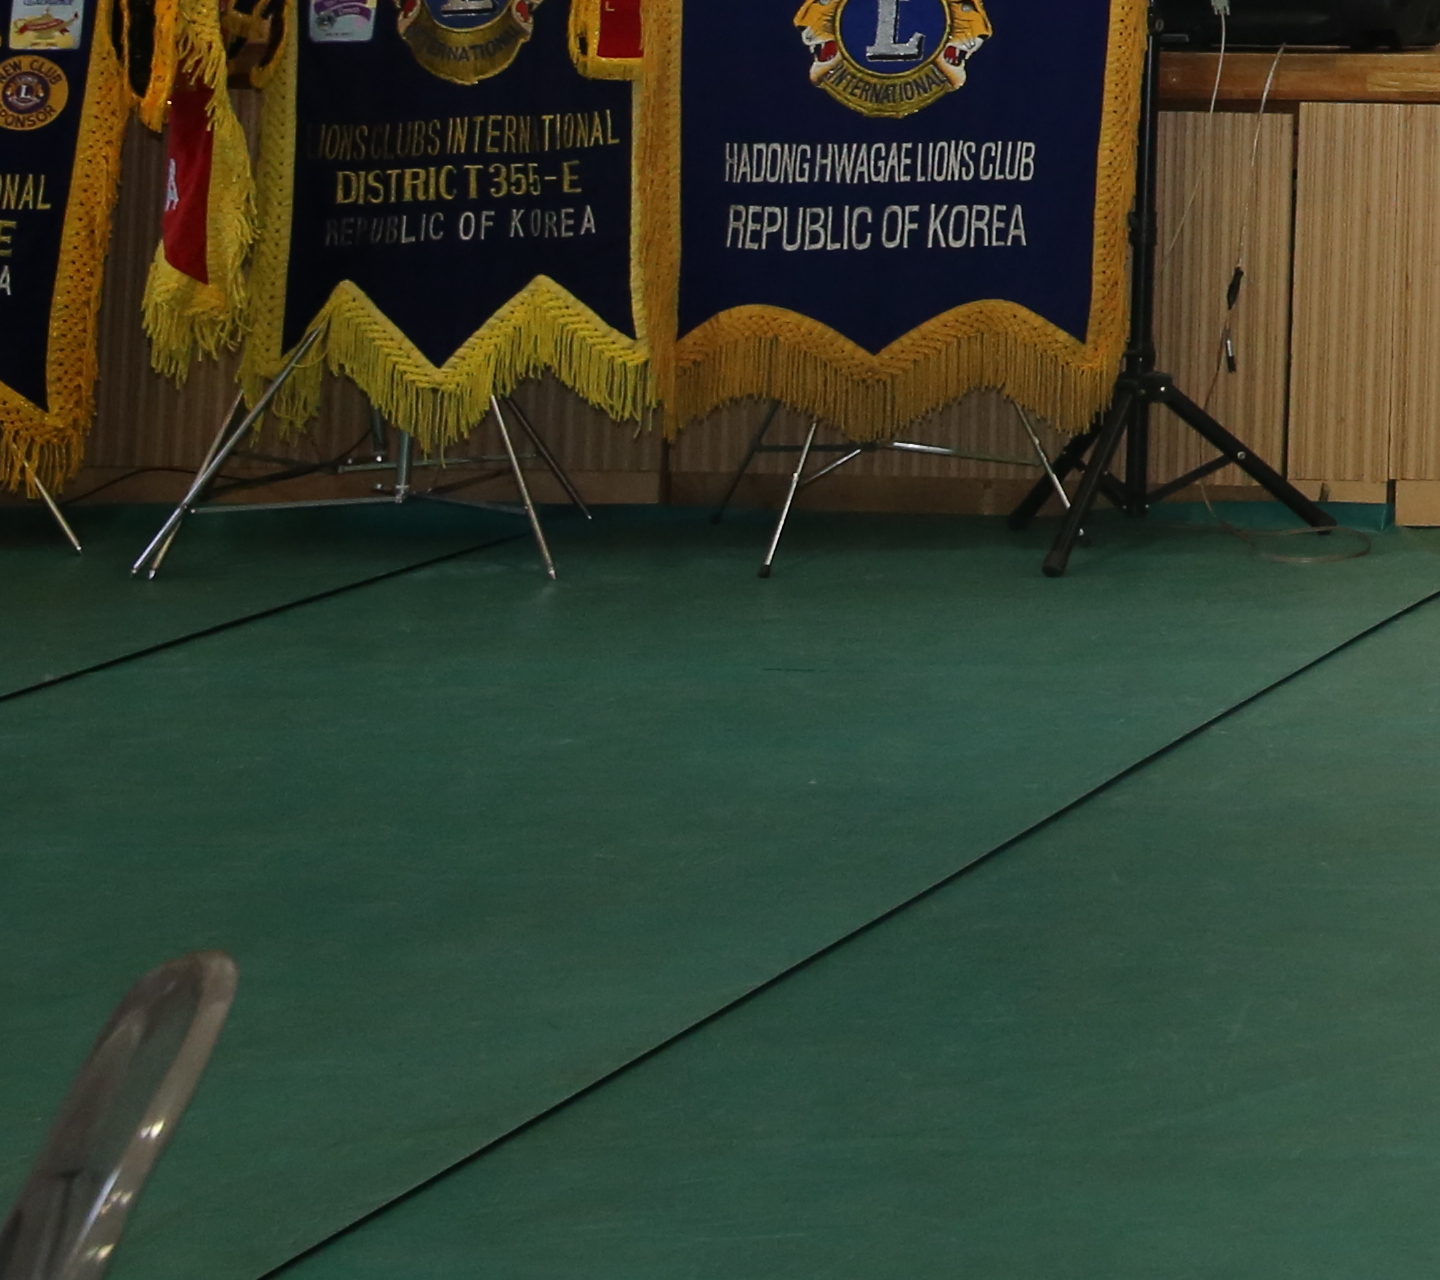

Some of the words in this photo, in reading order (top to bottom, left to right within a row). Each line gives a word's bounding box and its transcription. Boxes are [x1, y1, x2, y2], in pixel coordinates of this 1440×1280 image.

[29, 58, 63, 87] CLUB
[824, 65, 951, 105] INTERNATIONAL
[335, 164, 484, 205] DISTRICT
[489, 160, 582, 198] 355-E
[724, 141, 810, 185] HADONG
[812, 141, 913, 184] HWAGAE
[915, 140, 976, 182] LIONS
[978, 139, 1036, 182] CLUB
[458, 210, 496, 240] OF
[509, 204, 597, 239] KOREA
[726, 205, 874, 252] REPUBLIC
[880, 204, 921, 250] OF
[926, 203, 1028, 250] KOREA
